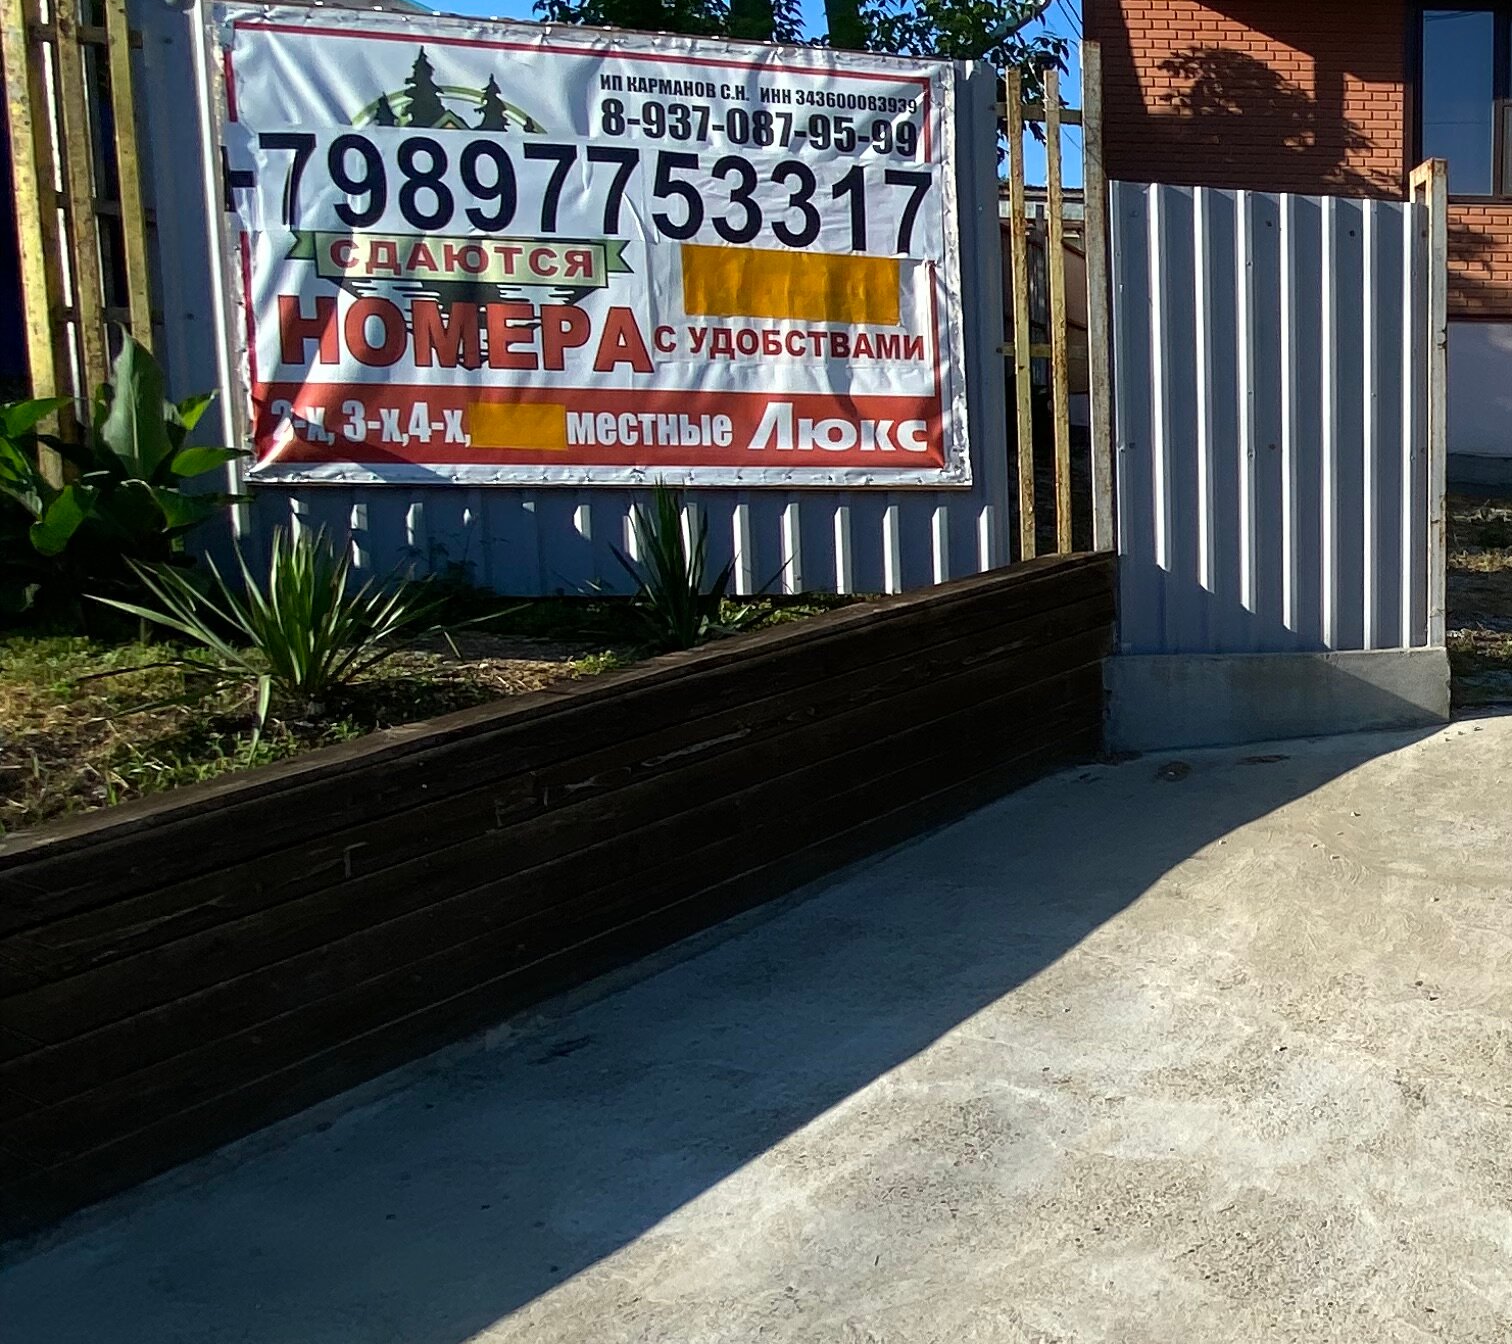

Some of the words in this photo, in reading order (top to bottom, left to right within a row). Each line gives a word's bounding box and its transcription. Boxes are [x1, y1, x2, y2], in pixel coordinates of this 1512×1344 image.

[600, 74, 623, 91] ИП
[626, 76, 717, 98] КАРМАНОВ
[720, 83, 750, 101] С.Н.
[760, 87, 792, 104] ИНН
[795, 89, 917, 114] 343600083939
[601, 98, 918, 157] 8-937-087-95-99
[329, 238, 595, 279] СДАЮТСЯ
[278, 294, 655, 373] НОМЕРА
[687, 327, 925, 361] УДОБСТВАМИ
[566, 411, 733, 448] местные
[747, 402, 929, 453] Люкс
